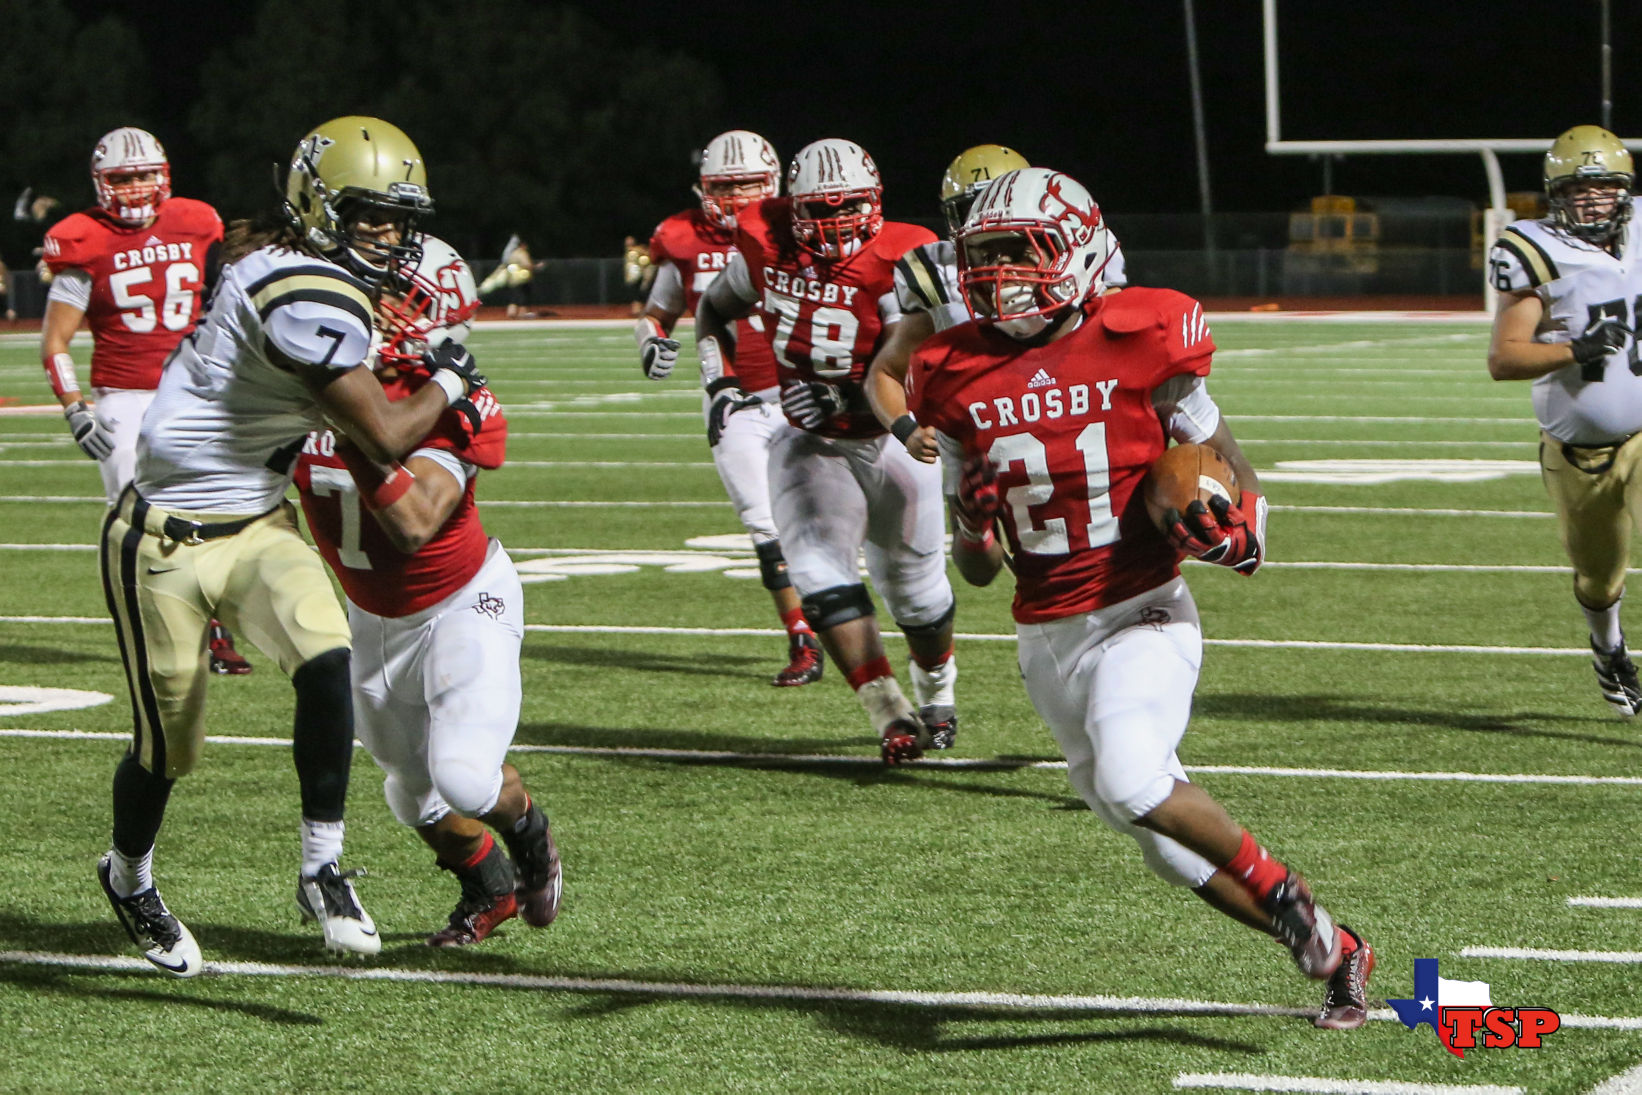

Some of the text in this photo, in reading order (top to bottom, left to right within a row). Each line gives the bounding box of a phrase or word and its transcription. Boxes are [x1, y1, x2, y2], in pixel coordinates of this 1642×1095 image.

[402, 160, 413, 182] 7
[970, 166, 991, 182] 71
[113, 242, 193, 270] CROSBY
[109, 262, 200, 333] 56
[762, 266, 859, 307] CROSBY
[315, 324, 346, 366] 7
[763, 287, 860, 378] 78
[1581, 293, 1642, 382] 7
[968, 378, 1119, 430] CROSBY
[986, 420, 1122, 556] 21
[309, 463, 374, 570] 7
